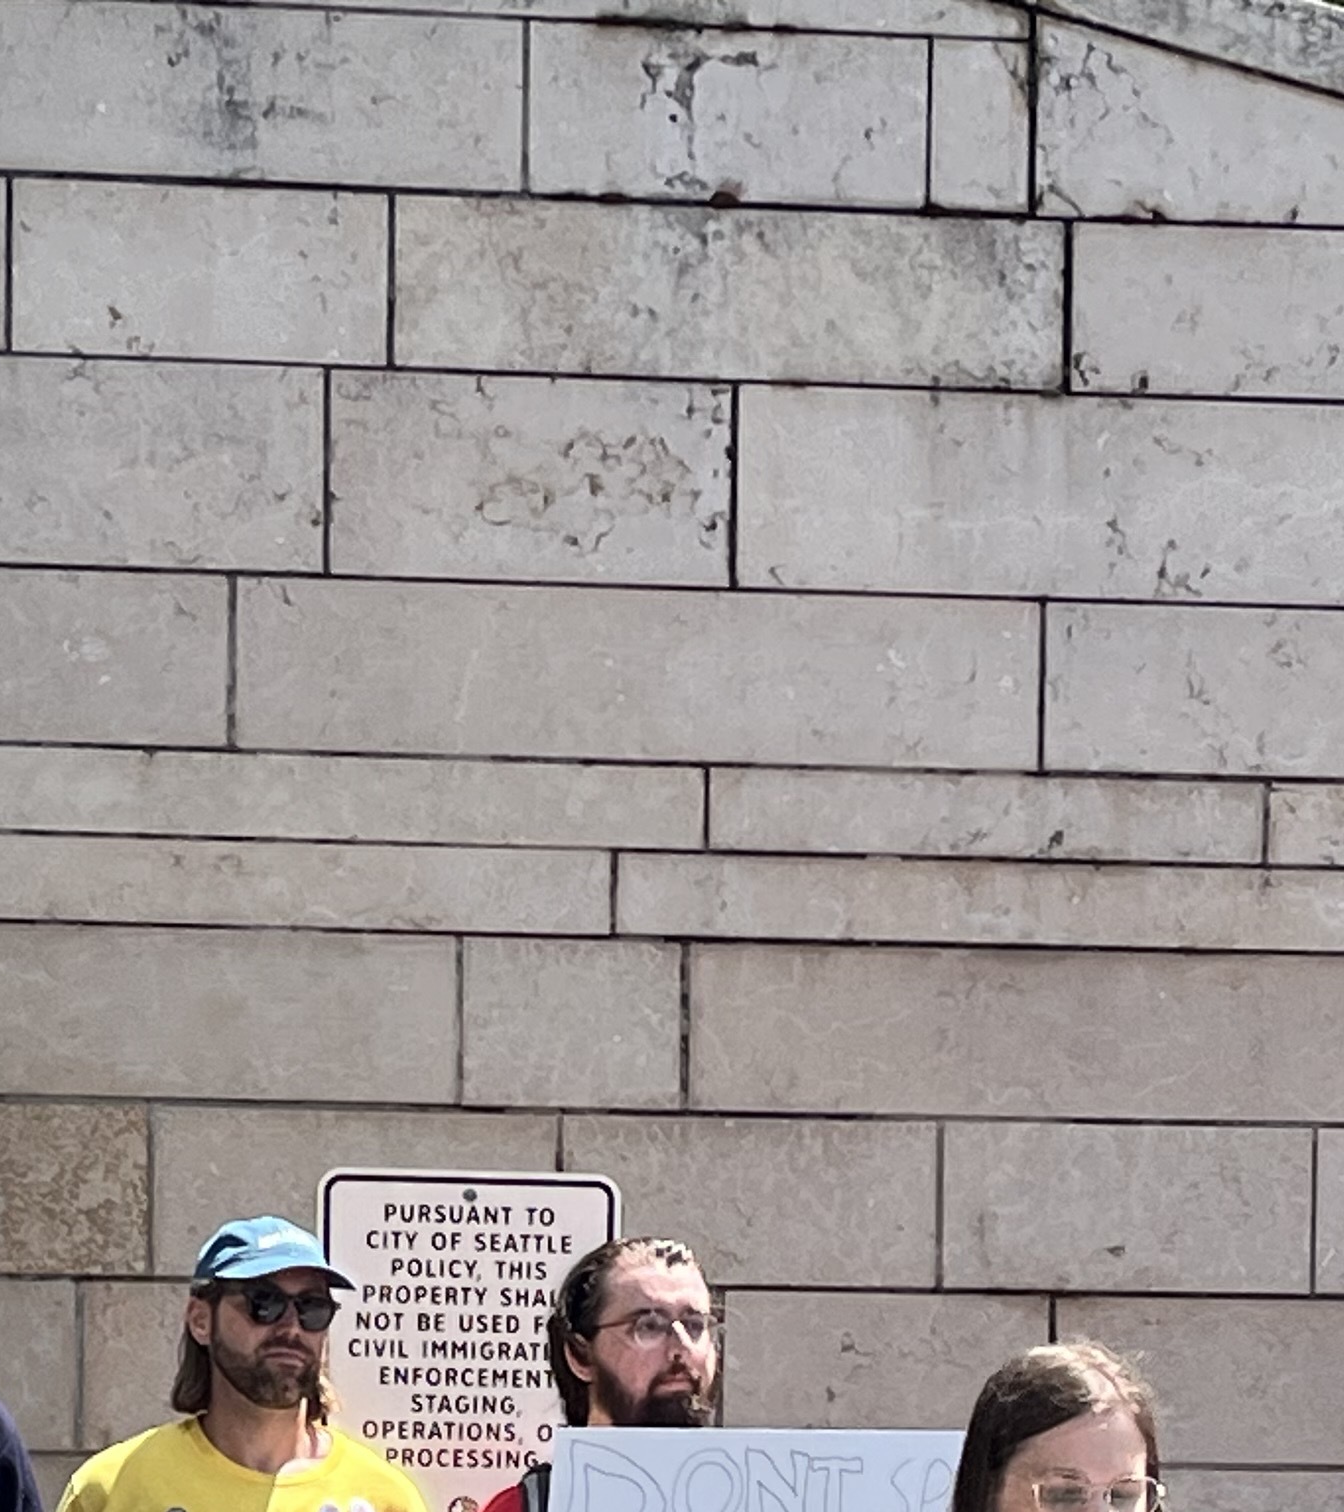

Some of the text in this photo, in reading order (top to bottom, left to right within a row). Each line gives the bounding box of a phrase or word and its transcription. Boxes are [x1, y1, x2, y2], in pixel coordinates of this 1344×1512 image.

[384, 1204, 555, 1226] PURSUANT TO
[366, 1230, 572, 1254] CITY OF SEATTLE
[391, 1259, 547, 1281] POLICY, THIS
[362, 1285, 557, 1308] PROPERTY SHAL
[356, 1312, 403, 1332] NOT
[418, 1314, 445, 1332] BE
[459, 1315, 519, 1334] USED
[348, 1338, 550, 1361] CIVIL IMMIGRATI
[379, 1367, 555, 1389] ENFORCEMENT
[411, 1394, 521, 1418] STAGING,
[363, 1421, 553, 1445] OPERATIONS, O
[386, 1448, 537, 1468] PROCESSING
